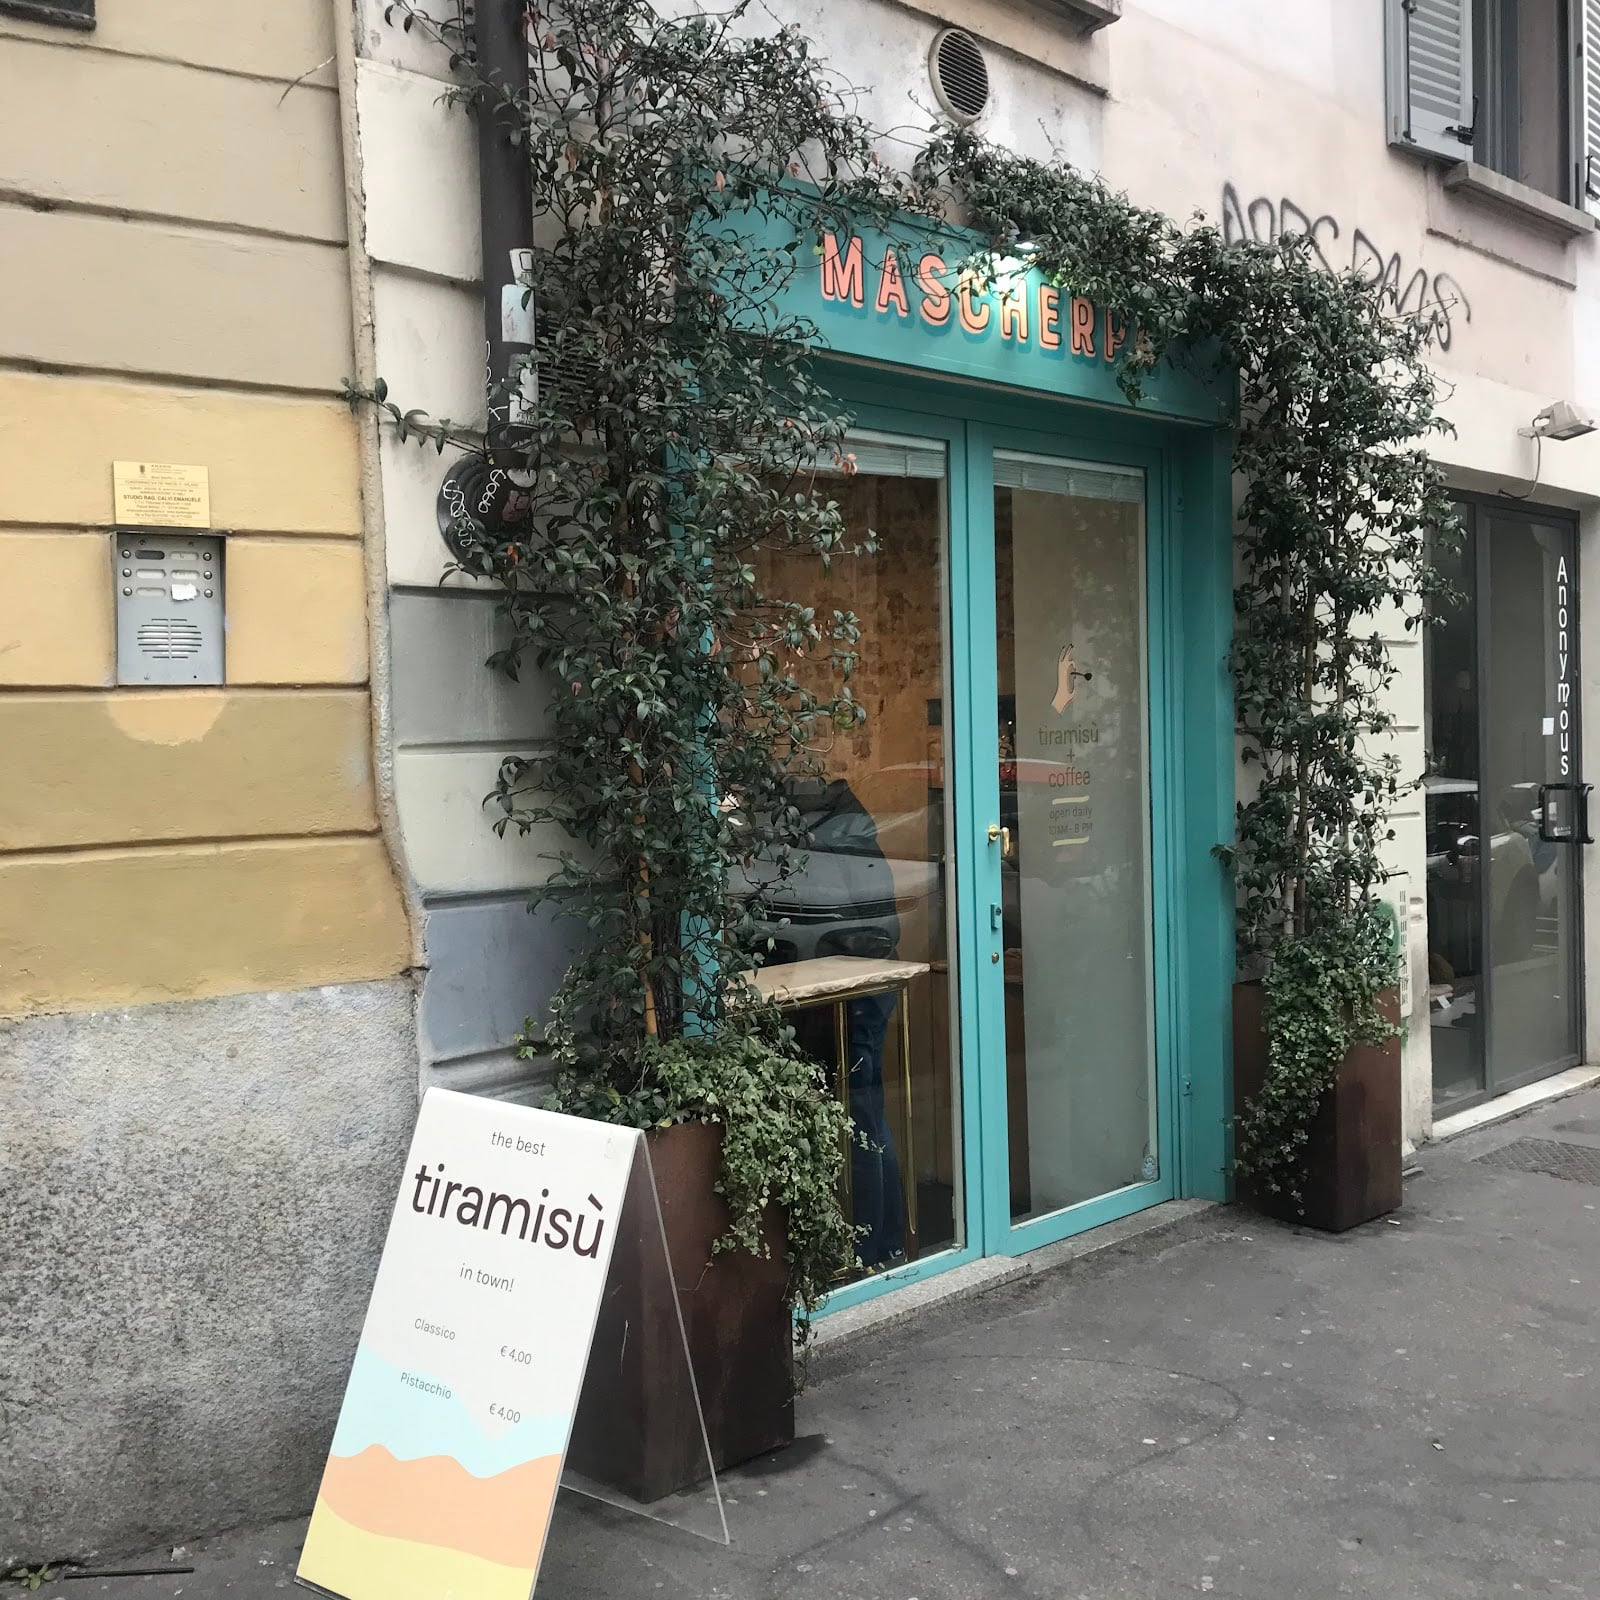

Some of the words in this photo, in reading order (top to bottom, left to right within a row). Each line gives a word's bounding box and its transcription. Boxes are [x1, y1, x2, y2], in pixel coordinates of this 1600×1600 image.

[820, 233, 1149, 363] MASCHERP
[1557, 556, 1570, 776] Anonymous
[1038, 721, 1099, 746] tiramisù
[1048, 766, 1091, 788] coffee
[1049, 808, 1071, 821] open
[1072, 806, 1093, 819] daily
[491, 1131, 513, 1149] the
[516, 1136, 547, 1156] best
[412, 1163, 605, 1259] tiramisù
[459, 1263, 473, 1281] in
[476, 1269, 514, 1293] town!
[414, 1318, 456, 1341] Classico
[400, 1372, 452, 1400] Pistacchio
